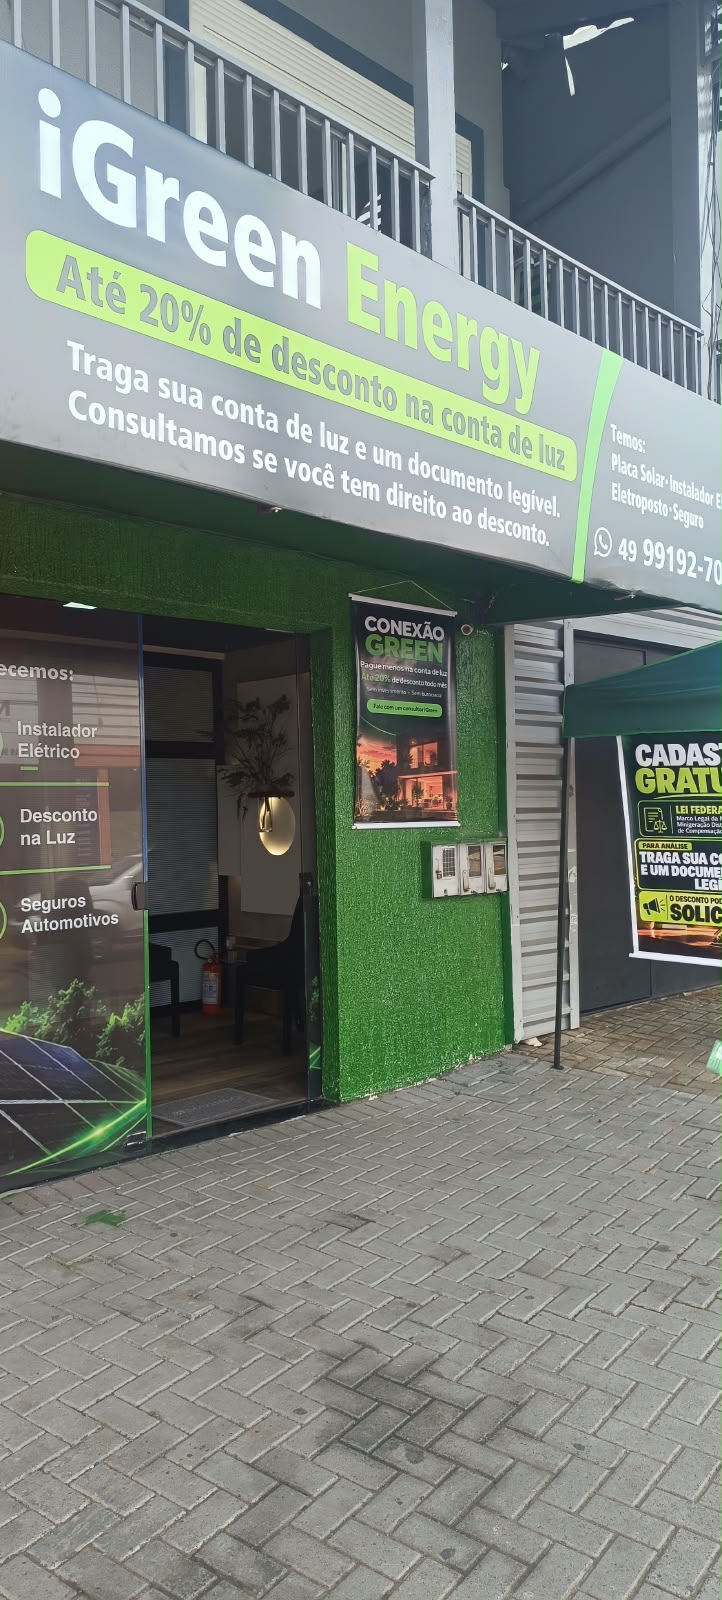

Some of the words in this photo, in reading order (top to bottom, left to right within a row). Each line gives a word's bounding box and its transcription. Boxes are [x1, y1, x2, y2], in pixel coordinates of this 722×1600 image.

[38, 87, 321, 310] iGreen
[346, 242, 540, 415] Energy
[56, 255, 126, 315] Até
[140, 284, 212, 345] 20%
[222, 317, 262, 364] de
[271, 336, 397, 411] desconto
[406, 392, 434, 425] na
[442, 407, 502, 449] conta
[508, 425, 532, 459] de
[538, 433, 565, 471] luz
[67, 340, 149, 394] Traga
[158, 377, 203, 410] sua
[212, 394, 278, 433] conta
[286, 412, 313, 444] de
[320, 421, 350, 455] luz
[355, 440, 367, 460] e
[373, 445, 402, 471] um
[408, 452, 503, 500] documento
[508, 480, 561, 518] legível.
[610, 424, 646, 454] Temos:
[68, 389, 246, 464] Consultamos
[252, 448, 278, 473] se
[284, 457, 335, 490] você
[340, 470, 380, 502] tem
[386, 481, 447, 519] direito
[452, 505, 473, 526] ao
[478, 507, 550, 547] desconto.
[612, 452, 638, 480] Placa
[618, 537, 638, 563] 49
[364, 616, 444, 642] CONEXÃO
[365, 634, 444, 663] GREEN
[360, 660, 382, 670] Pague
[382, 664, 404, 672] menos
[414, 667, 431, 675] conta
[432, 668, 439, 676] de
[440, 669, 448, 677] luz
[375, 674, 391, 682] 20%
[392, 676, 399, 684] de
[400, 677, 424, 686] desconto
[425, 680, 436, 688] todo
[18, 720, 98, 738] Instalador
[18, 743, 80, 759] Elétrico
[635, 743, 722, 767] CADAS
[20, 808, 98, 824] Desconto
[676, 806, 688, 814] LEI
[20, 832, 40, 846] na
[46, 830, 76, 845] Luz
[639, 851, 681, 864] TRAGA
[682, 852, 708, 865] SUA
[641, 864, 648, 875] E
[650, 864, 669, 876] UM
[20, 895, 86, 914] Seguros
[676, 896, 709, 904] DESCONTO
[21, 911, 120, 934] Automotivos
